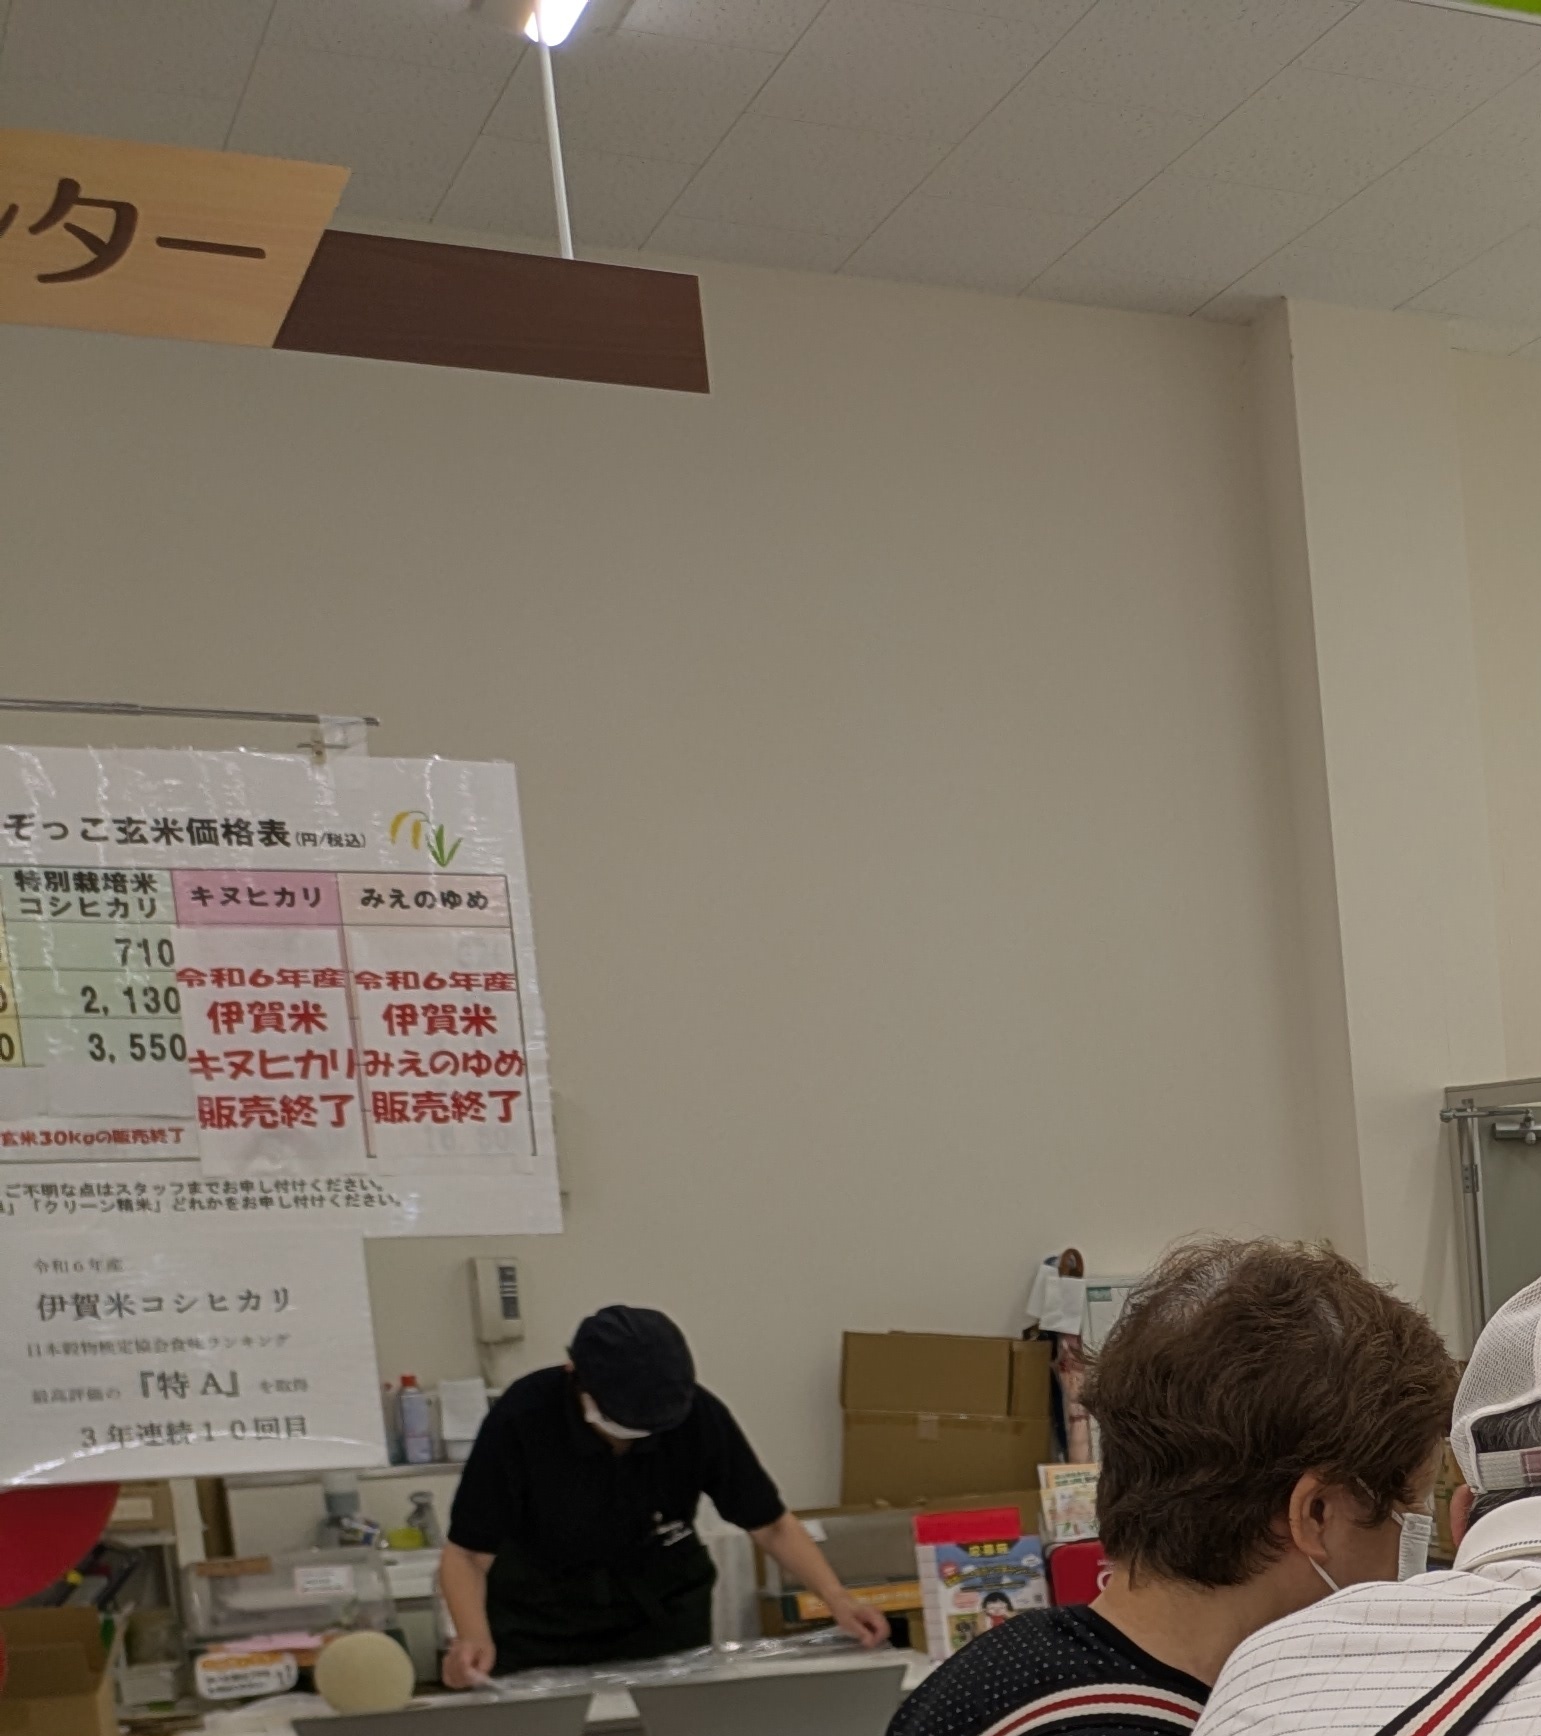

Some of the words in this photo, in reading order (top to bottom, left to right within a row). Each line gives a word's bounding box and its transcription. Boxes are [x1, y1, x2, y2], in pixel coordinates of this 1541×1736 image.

[3, 814, 292, 848] ぞっこ玄米価格表
[15, 870, 157, 895] 特別栽培米
[191, 886, 322, 908] キヌヒカリ
[20, 897, 157, 919] コシヒカリ
[360, 888, 490, 911] みえのゆめ
[115, 938, 175, 967] 710
[177, 967, 346, 989] 令和6年産
[355, 970, 517, 992] 令和6年産
[81, 986, 181, 1016] 2,130
[206, 1000, 329, 1035] 伊賀米
[382, 1003, 498, 1037] 伊賀米
[89, 1033, 188, 1063] 3,550
[188, 1048, 356, 1081] キヌヒカリ
[364, 1049, 526, 1078] みえのゆめ
[197, 1093, 355, 1130] 販売終了
[371, 1090, 521, 1124] 販売終了
[37, 1287, 291, 1321] 伊賀米コシヒカリ
